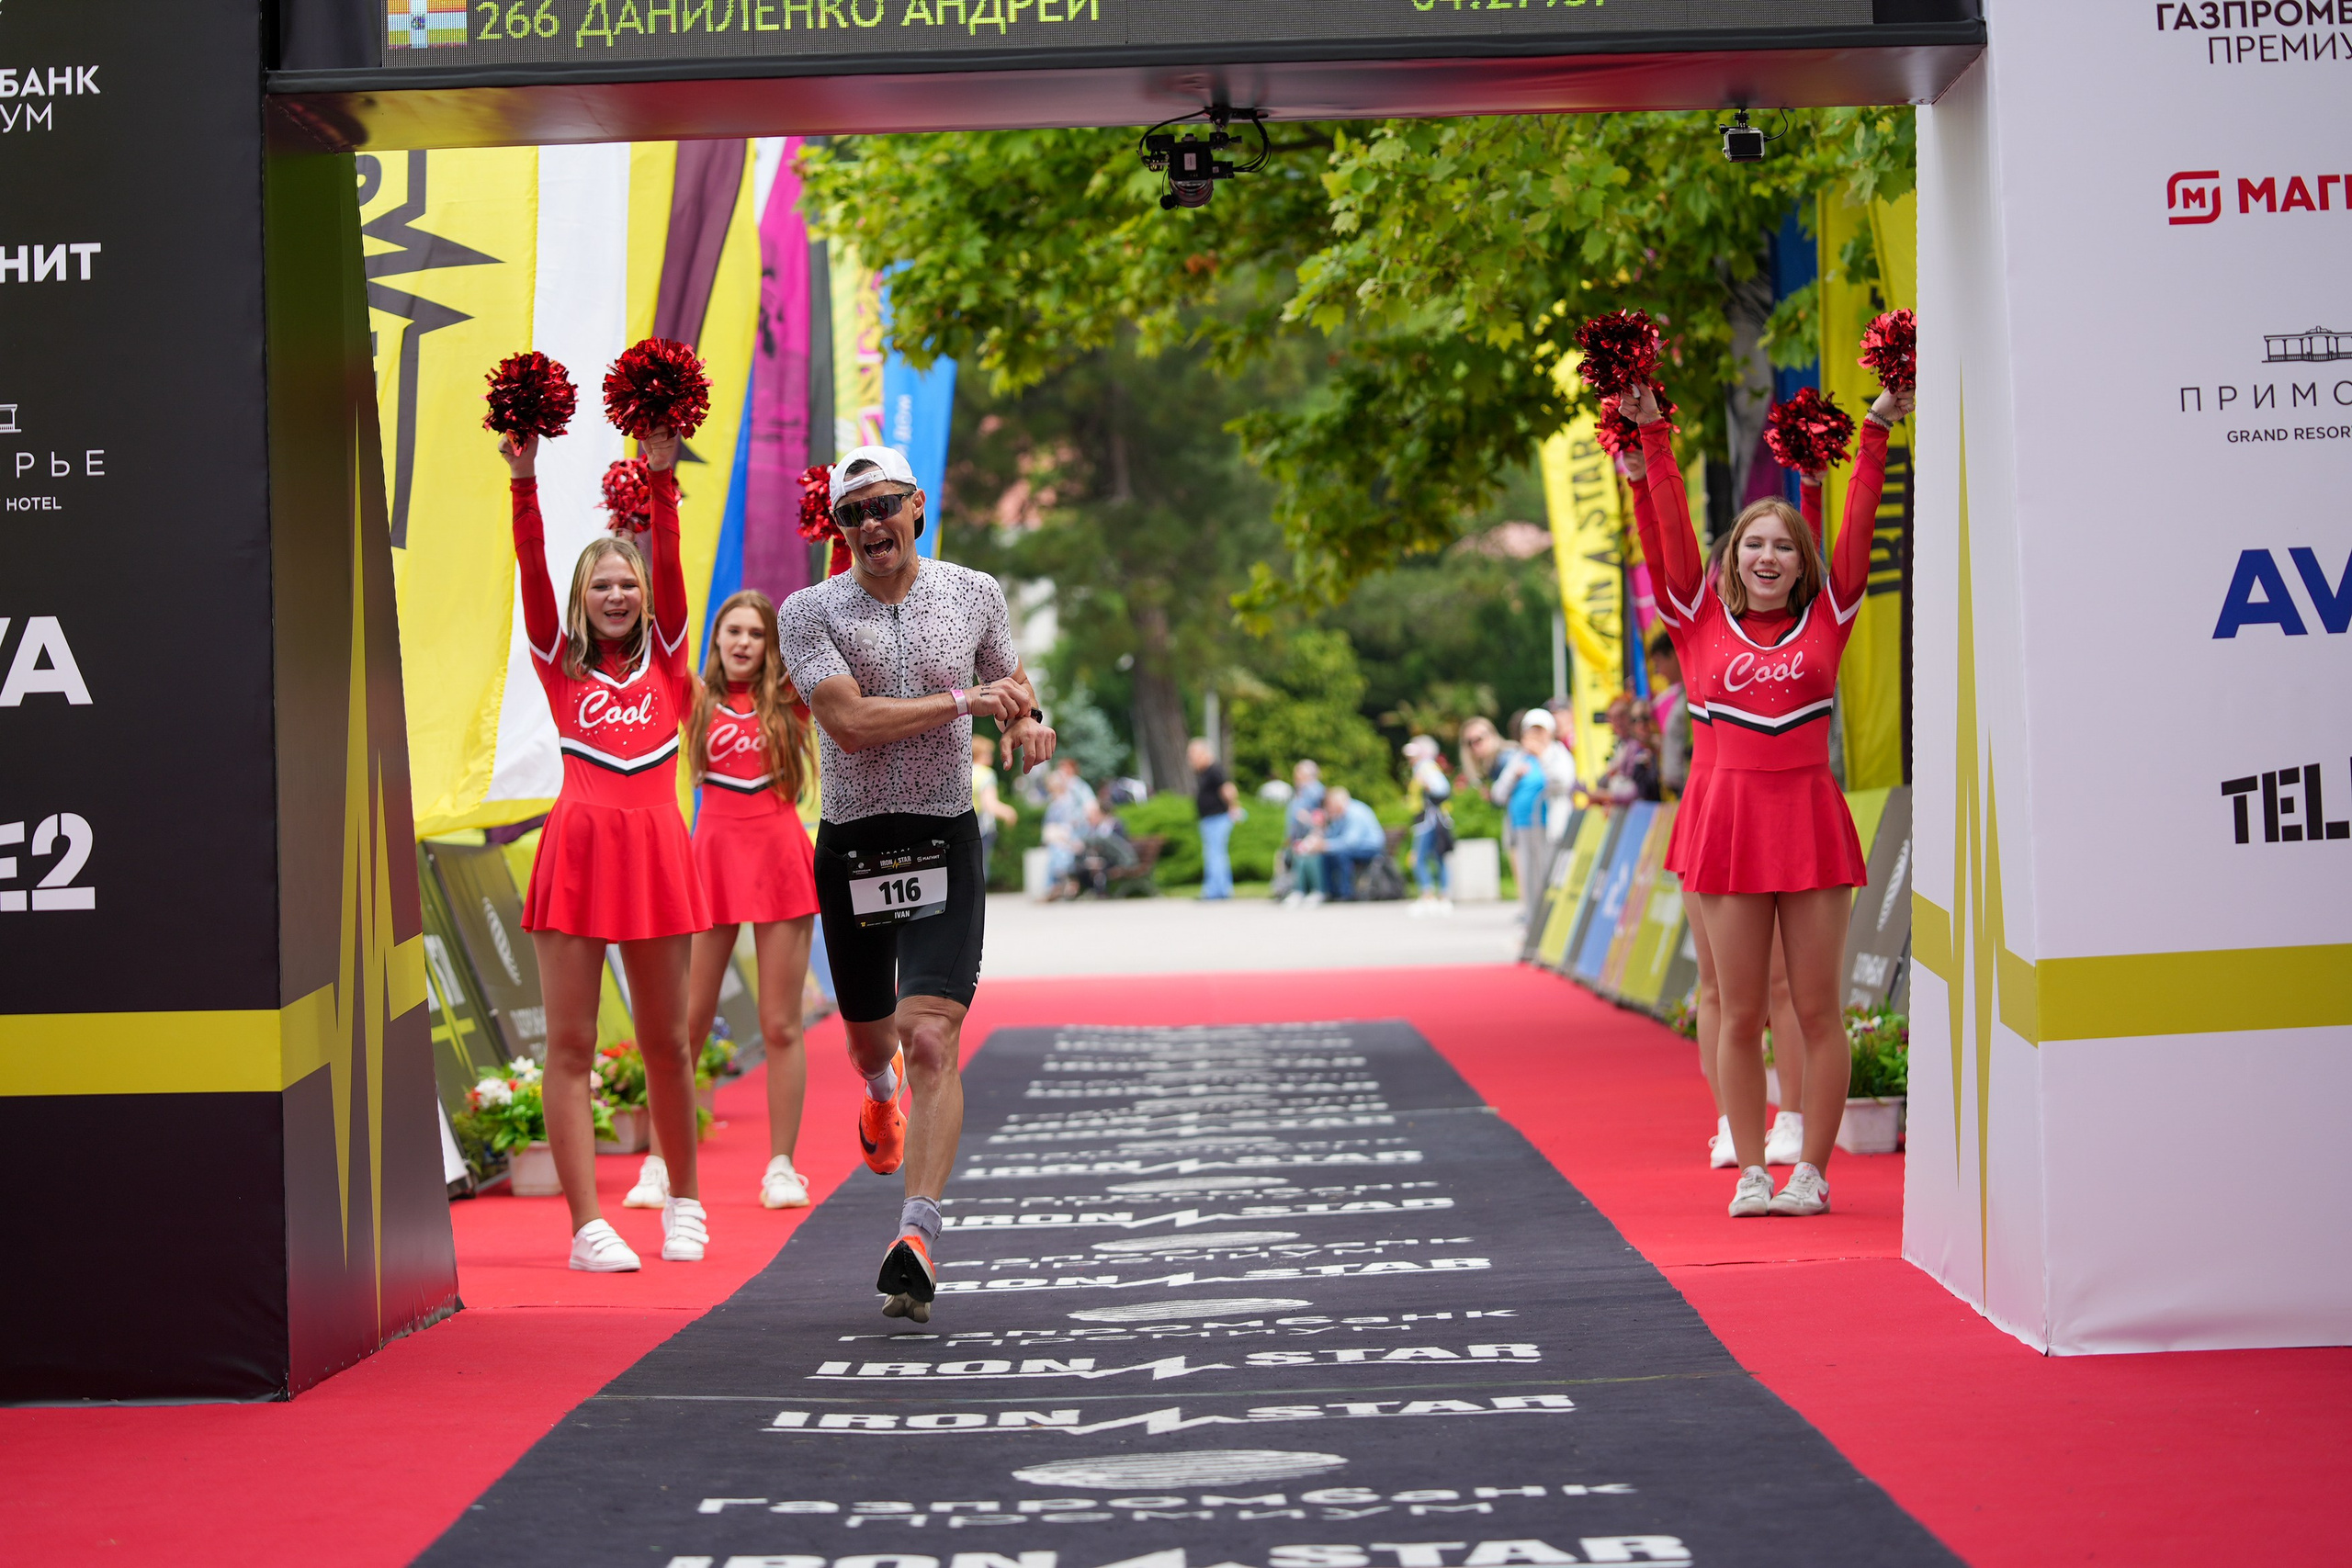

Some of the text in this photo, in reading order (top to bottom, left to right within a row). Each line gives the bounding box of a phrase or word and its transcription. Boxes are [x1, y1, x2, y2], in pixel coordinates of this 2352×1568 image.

[476, 0, 560, 39] 266
[576, 0, 885, 48] ДАНИЛЕНКО
[0, 65, 101, 98] БАНК
[0, 101, 52, 134] УМ
[0, 242, 102, 283] НИТ
[2227, 425, 2352, 443] GRAND RESOR
[16, 450, 106, 479] РЬЕ
[6, 496, 62, 512] HOTEL
[0, 615, 94, 706] A
[1724, 650, 1805, 693] Cool
[579, 690, 652, 728] Cool
[707, 723, 767, 762] Coo
[2221, 762, 2352, 844] TEL
[878, 876, 922, 905] 116
[894, 910, 910, 919] IVAN
[935, 1258, 1491, 1291] RON STAR
[816, 1344, 1542, 1376] IRON STAR
[773, 1394, 1575, 1428] IRON STAR
[1269, 1535, 1691, 1568] STAR
